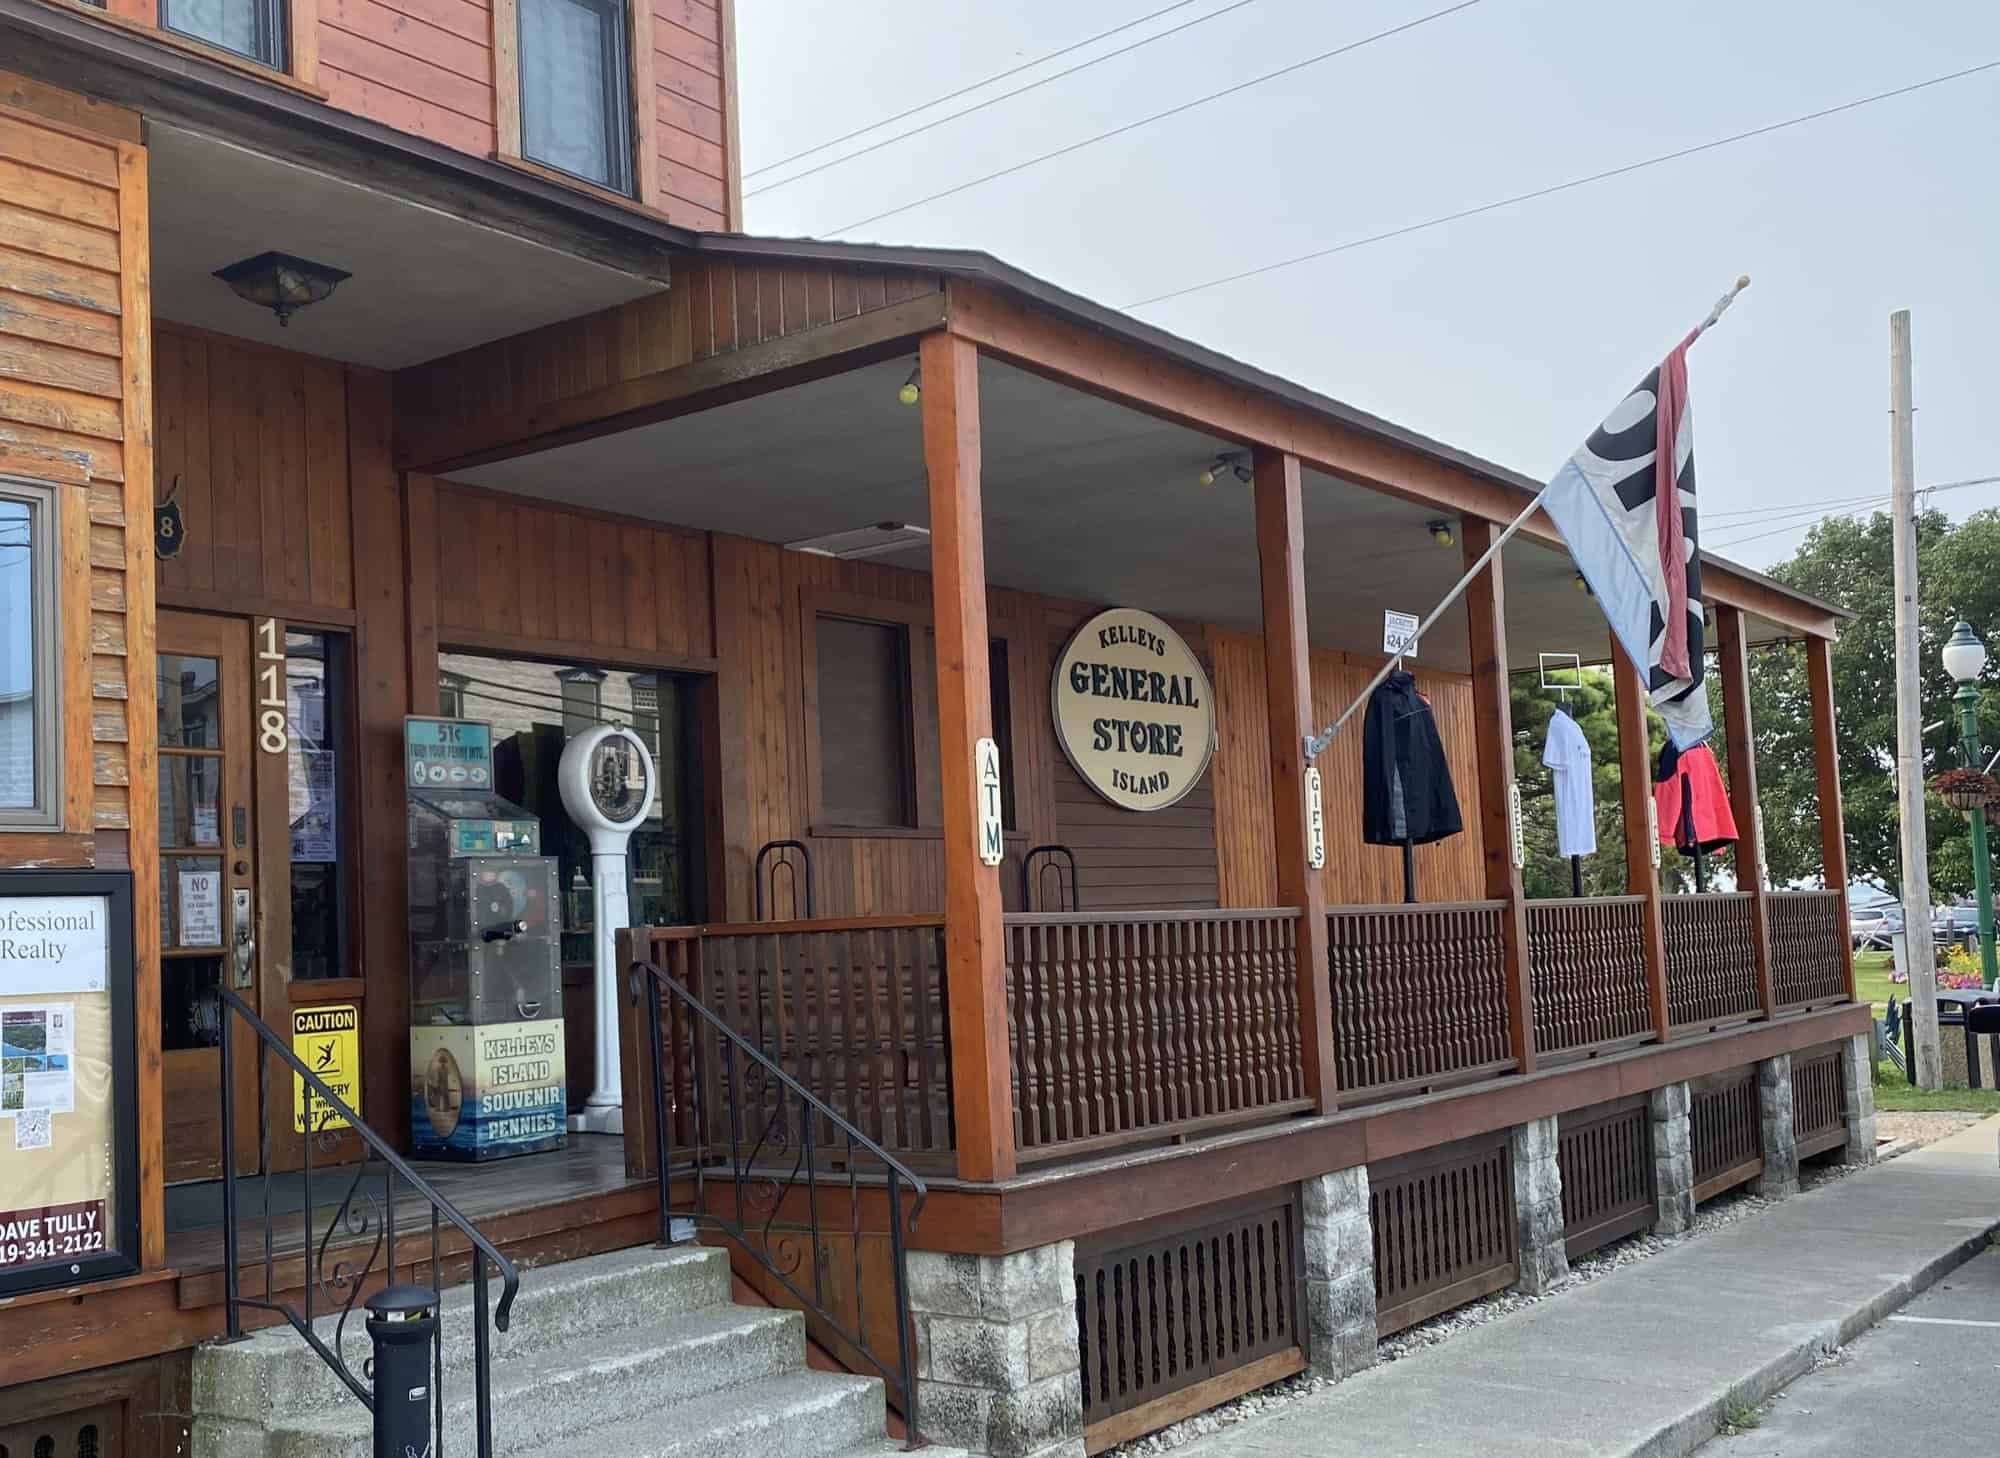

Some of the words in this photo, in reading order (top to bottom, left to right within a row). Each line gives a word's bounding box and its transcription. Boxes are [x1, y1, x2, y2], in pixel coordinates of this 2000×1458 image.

[160, 516, 174, 537] 8
[1099, 625, 1165, 656] KELLEYS
[259, 618, 287, 754] 118
[1070, 661, 1199, 708] GENERAL
[1093, 718, 1183, 757] STORE
[1112, 768, 1169, 795] ISLAND
[984, 751, 1000, 854] ATM
[1311, 776, 1322, 860] GIFTS
[191, 877, 209, 892] NO
[2, 938, 66, 964] Realty
[295, 1011, 354, 1031] CAUTION
[484, 1033, 555, 1060] KELLEYS
[491, 1060, 549, 1087] ISLAND
[302, 1083, 349, 1099] LIERY
[482, 1085, 560, 1114] SOUVENIR
[487, 1112, 556, 1140] PENNIES
[44, 1210, 97, 1235] TULLY
